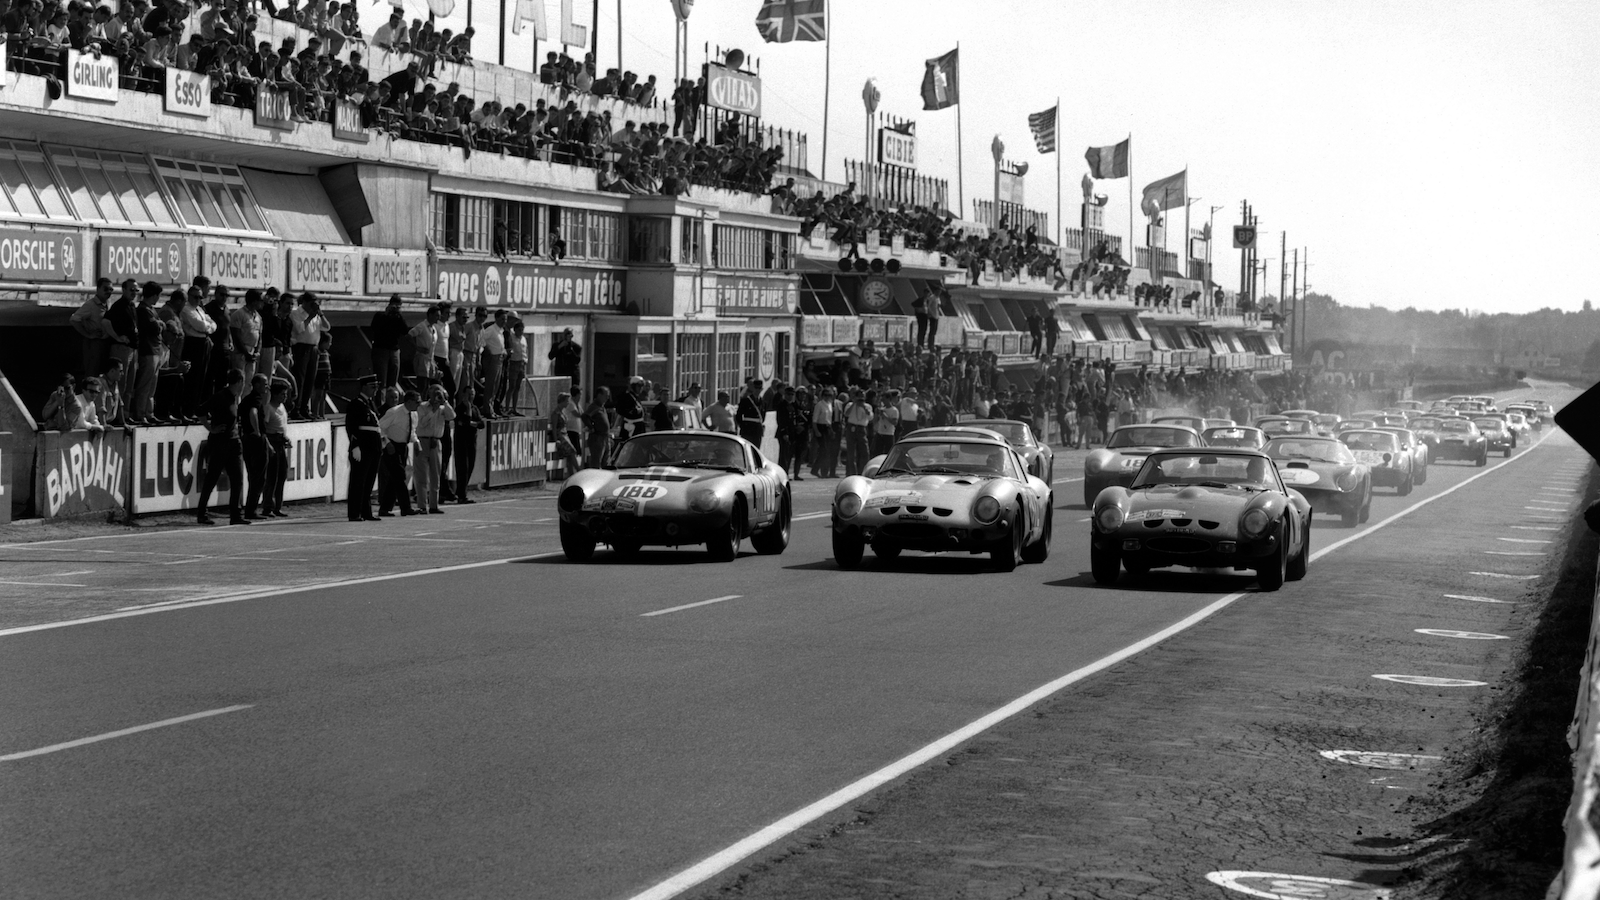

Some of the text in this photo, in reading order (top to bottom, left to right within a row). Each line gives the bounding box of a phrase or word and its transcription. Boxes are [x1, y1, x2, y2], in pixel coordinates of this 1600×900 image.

[73, 61, 112, 89] GIRLING
[1238, 230, 1253, 241] BP
[1, 238, 74, 271] ORSCHE 34
[108, 245, 180, 275] PORSCHE 32
[210, 250, 272, 279] PORSCHE 31
[297, 257, 339, 283] PORSCHE
[373, 261, 410, 285] PORSCHE
[438, 271, 479, 302] avec
[506, 266, 572, 309] toujours
[575, 278, 591, 305] en
[594, 271, 622, 305] tête
[511, 430, 546, 469] MARCHAL
[46, 436, 125, 518] BARDAHL
[140, 440, 231, 498] LUC
[617, 486, 659, 498] 188
